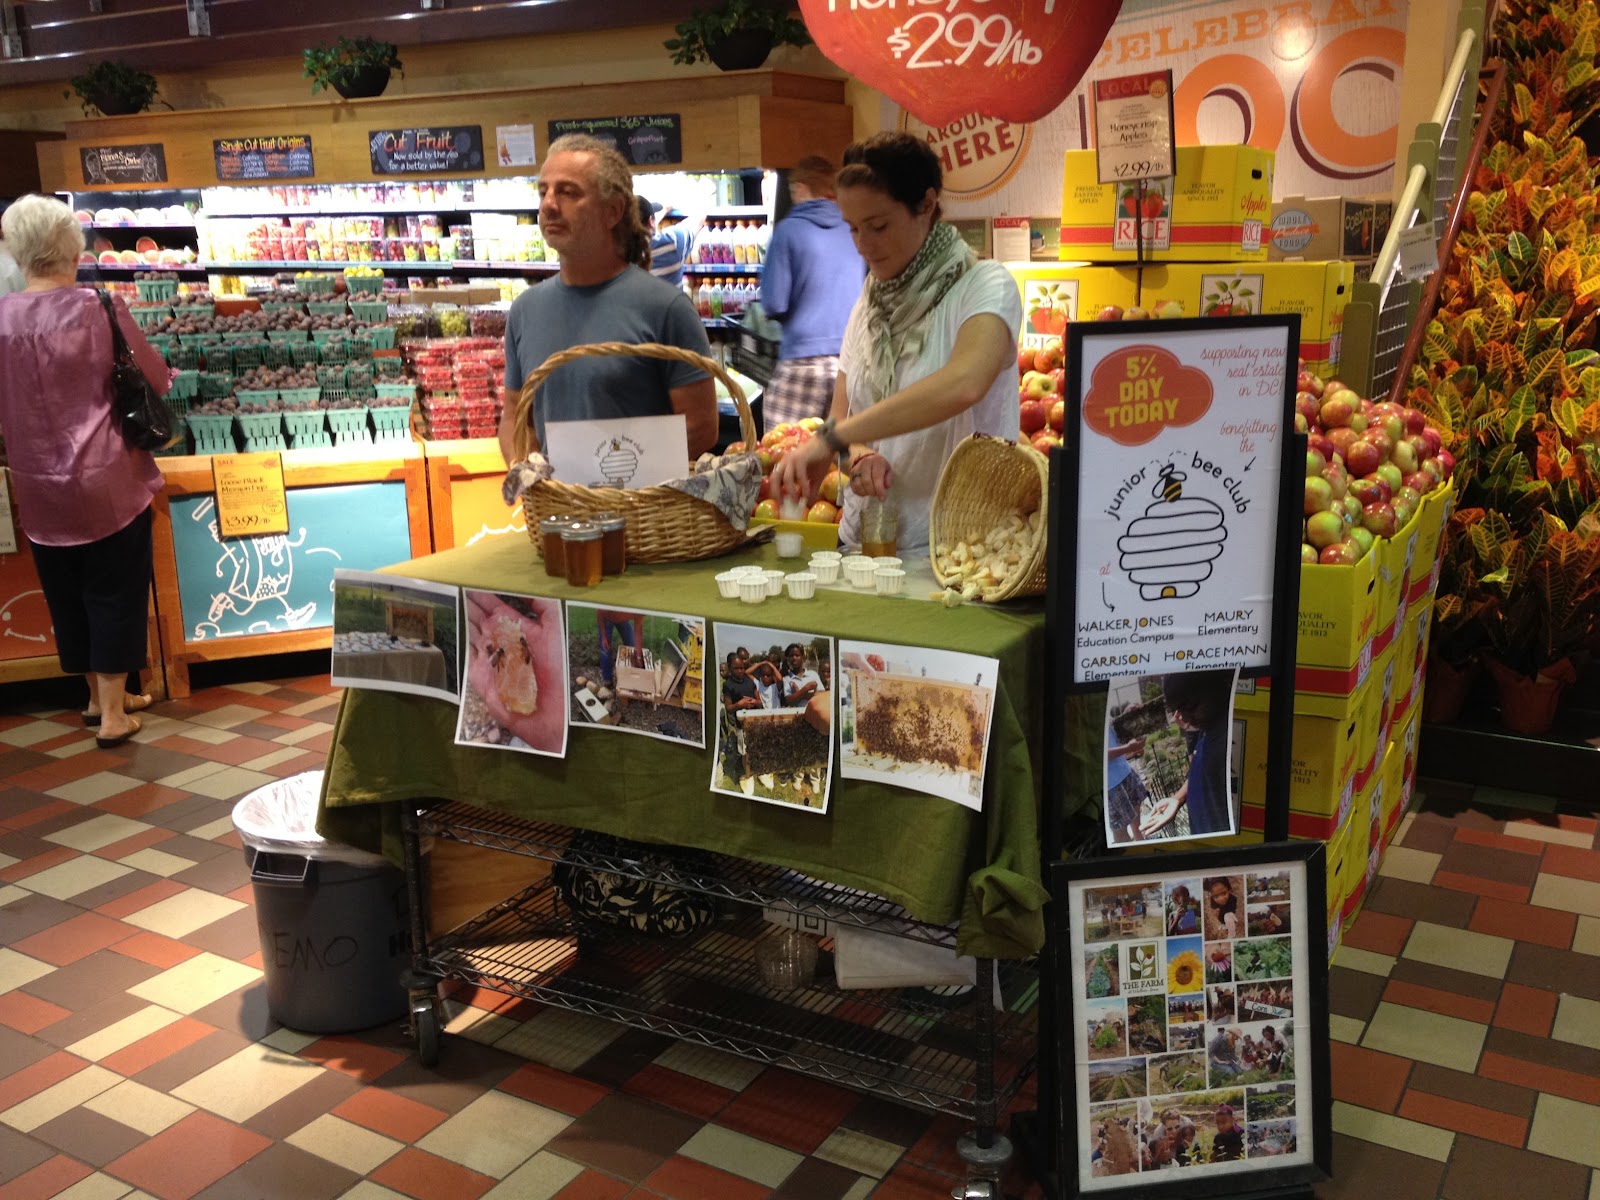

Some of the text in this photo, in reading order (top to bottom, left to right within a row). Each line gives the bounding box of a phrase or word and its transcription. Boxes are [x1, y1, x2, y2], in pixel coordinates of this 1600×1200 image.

[887, 12, 1042, 69] $2.99/lb
[1097, 0, 1397, 67] ELEBRA
[1101, 78, 1150, 97] LOCAL
[926, 113, 994, 144] AROUN
[1110, 121, 1157, 133] Honeycrisp
[278, 135, 306, 153] Origins
[384, 132, 407, 152] Cut
[416, 130, 455, 151] Fruit
[1119, 132, 1147, 142] Apples
[394, 151, 406, 160] Now
[408, 150, 423, 159] sold
[423, 150, 432, 161] by
[432, 149, 445, 158] the
[388, 160, 399, 171] for
[406, 160, 428, 170] better
[429, 160, 449, 170] value!
[1240, 192, 1267, 216] Apples
[1278, 213, 1307, 225] WHOLE
[1117, 220, 1166, 240] RICE
[1243, 223, 1261, 242] RICE
[1274, 226, 1310, 238] Produce
[1279, 238, 1306, 247] FOODS
[1200, 344, 1286, 367] supporting new
[1126, 354, 1156, 378] 5%
[1227, 364, 1284, 378] real estate
[1120, 376, 1164, 403] DAY
[1239, 380, 1283, 397] in DC!
[1105, 398, 1179, 428] TODAY
[1239, 438, 1255, 453] the
[1104, 451, 1250, 521] junior bee club
[1099, 562, 1111, 576] at
[1204, 609, 1253, 623] MAURY
[1298, 611, 1323, 619] AVOR
[1078, 615, 1174, 632] WALKER JONES
[1198, 625, 1258, 636] Elementary
[1077, 633, 1174, 647] Education Campus
[1081, 653, 1150, 669] GARRISON
[1164, 644, 1267, 662] HORACE MANN
[1122, 979, 1164, 990] THE FARM
[1251, 1003, 1268, 1013] Corn
